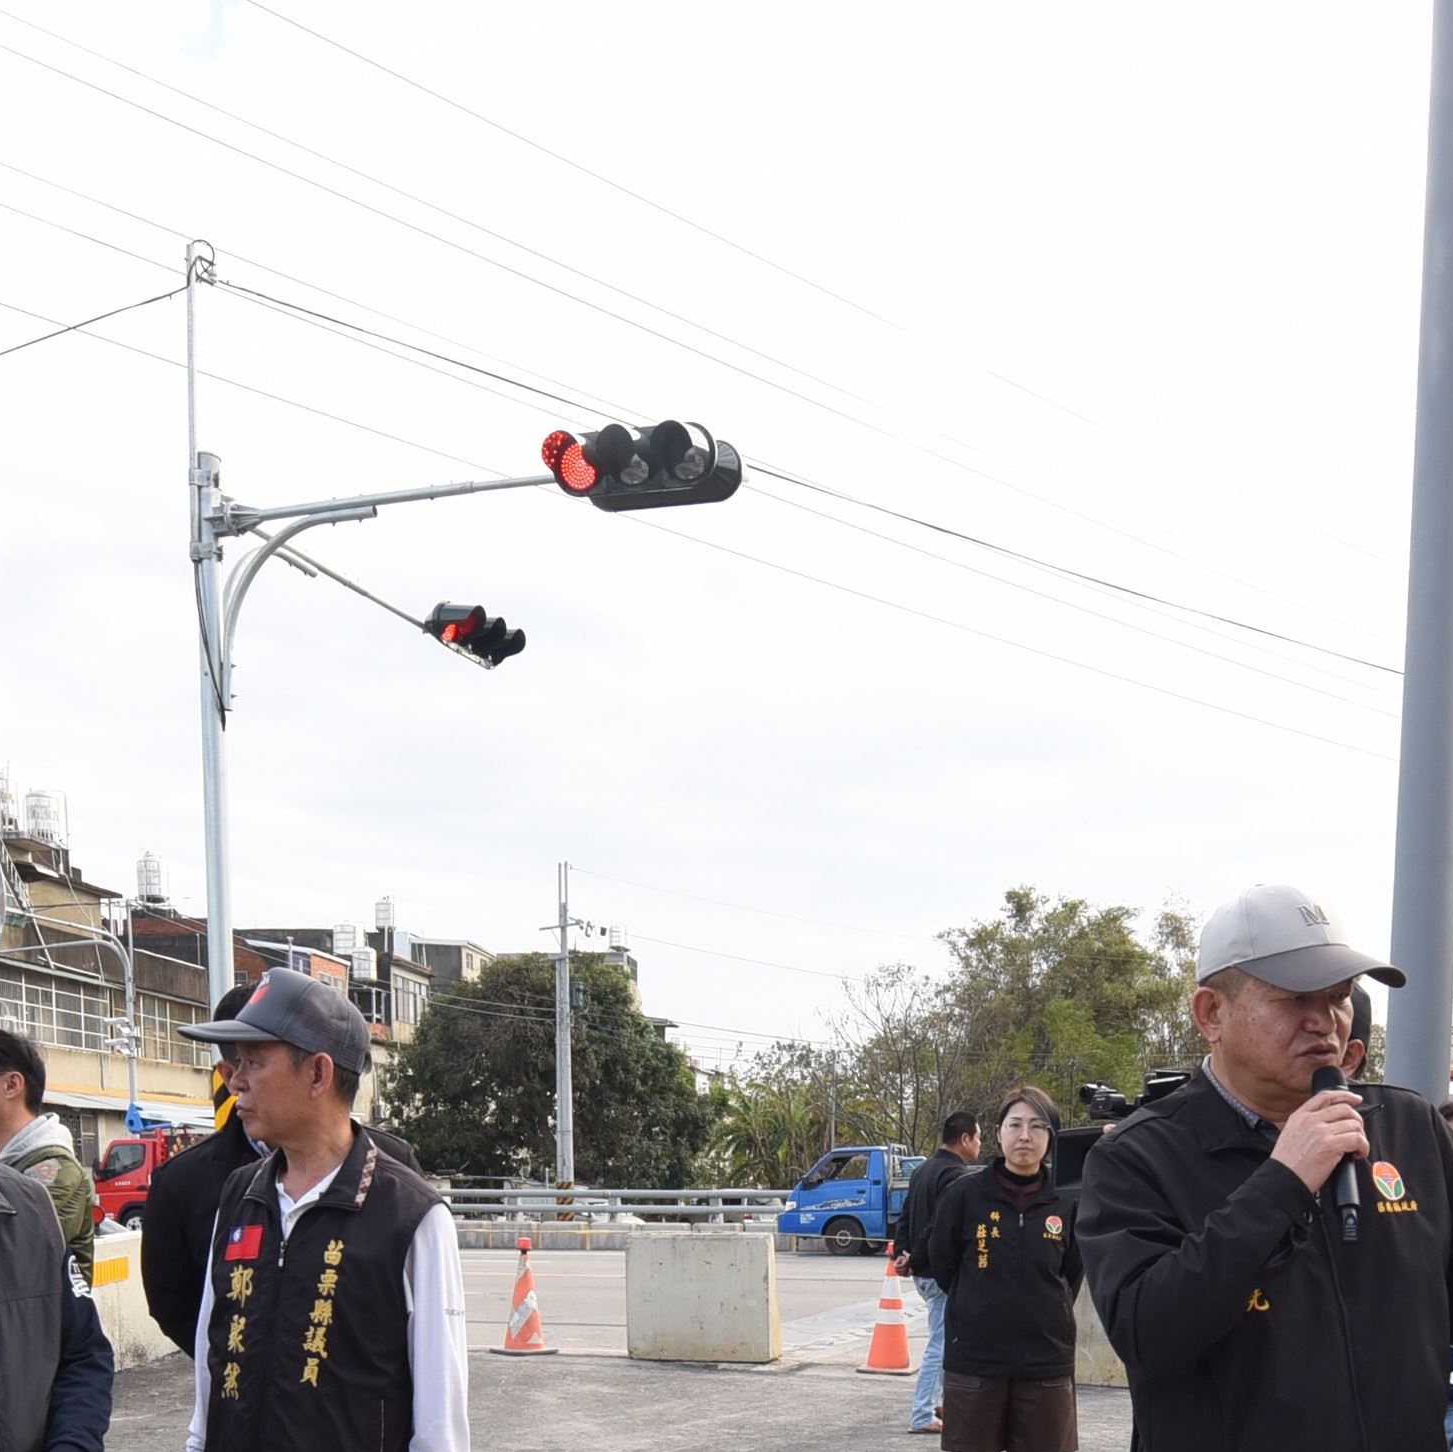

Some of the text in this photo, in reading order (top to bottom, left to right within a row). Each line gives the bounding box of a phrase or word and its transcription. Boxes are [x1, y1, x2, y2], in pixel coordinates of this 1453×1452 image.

[1296, 905, 1330, 927] M
[299, 1239, 345, 1387] 苗栗縣議員
